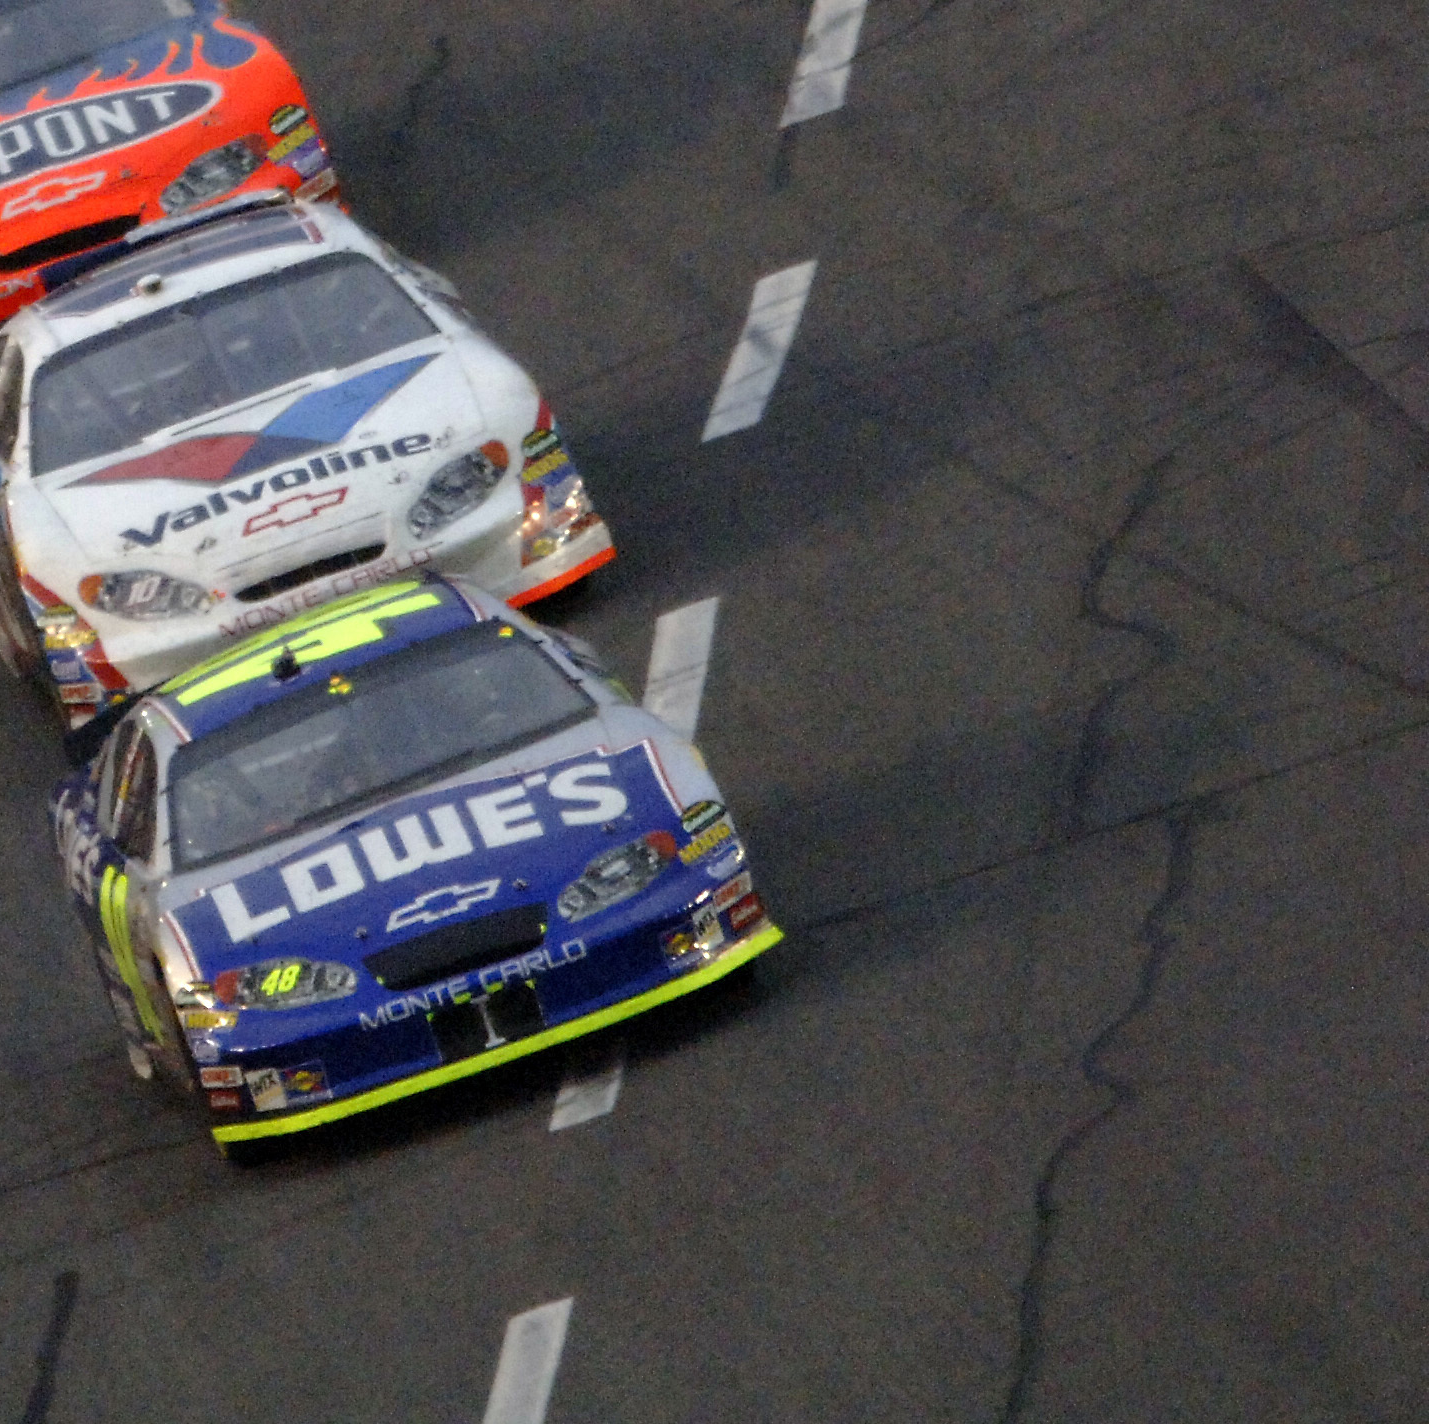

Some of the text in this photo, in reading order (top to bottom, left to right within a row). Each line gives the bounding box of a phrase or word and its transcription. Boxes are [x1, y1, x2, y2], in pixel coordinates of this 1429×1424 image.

[121, 432, 430, 548] Valvoline
[128, 577, 161, 606] 10
[219, 548, 432, 638] MONTE CARLO
[210, 763, 629, 942] LOWE'S
[261, 963, 301, 996] 48
[359, 937, 588, 1031] MONTE CARLO
